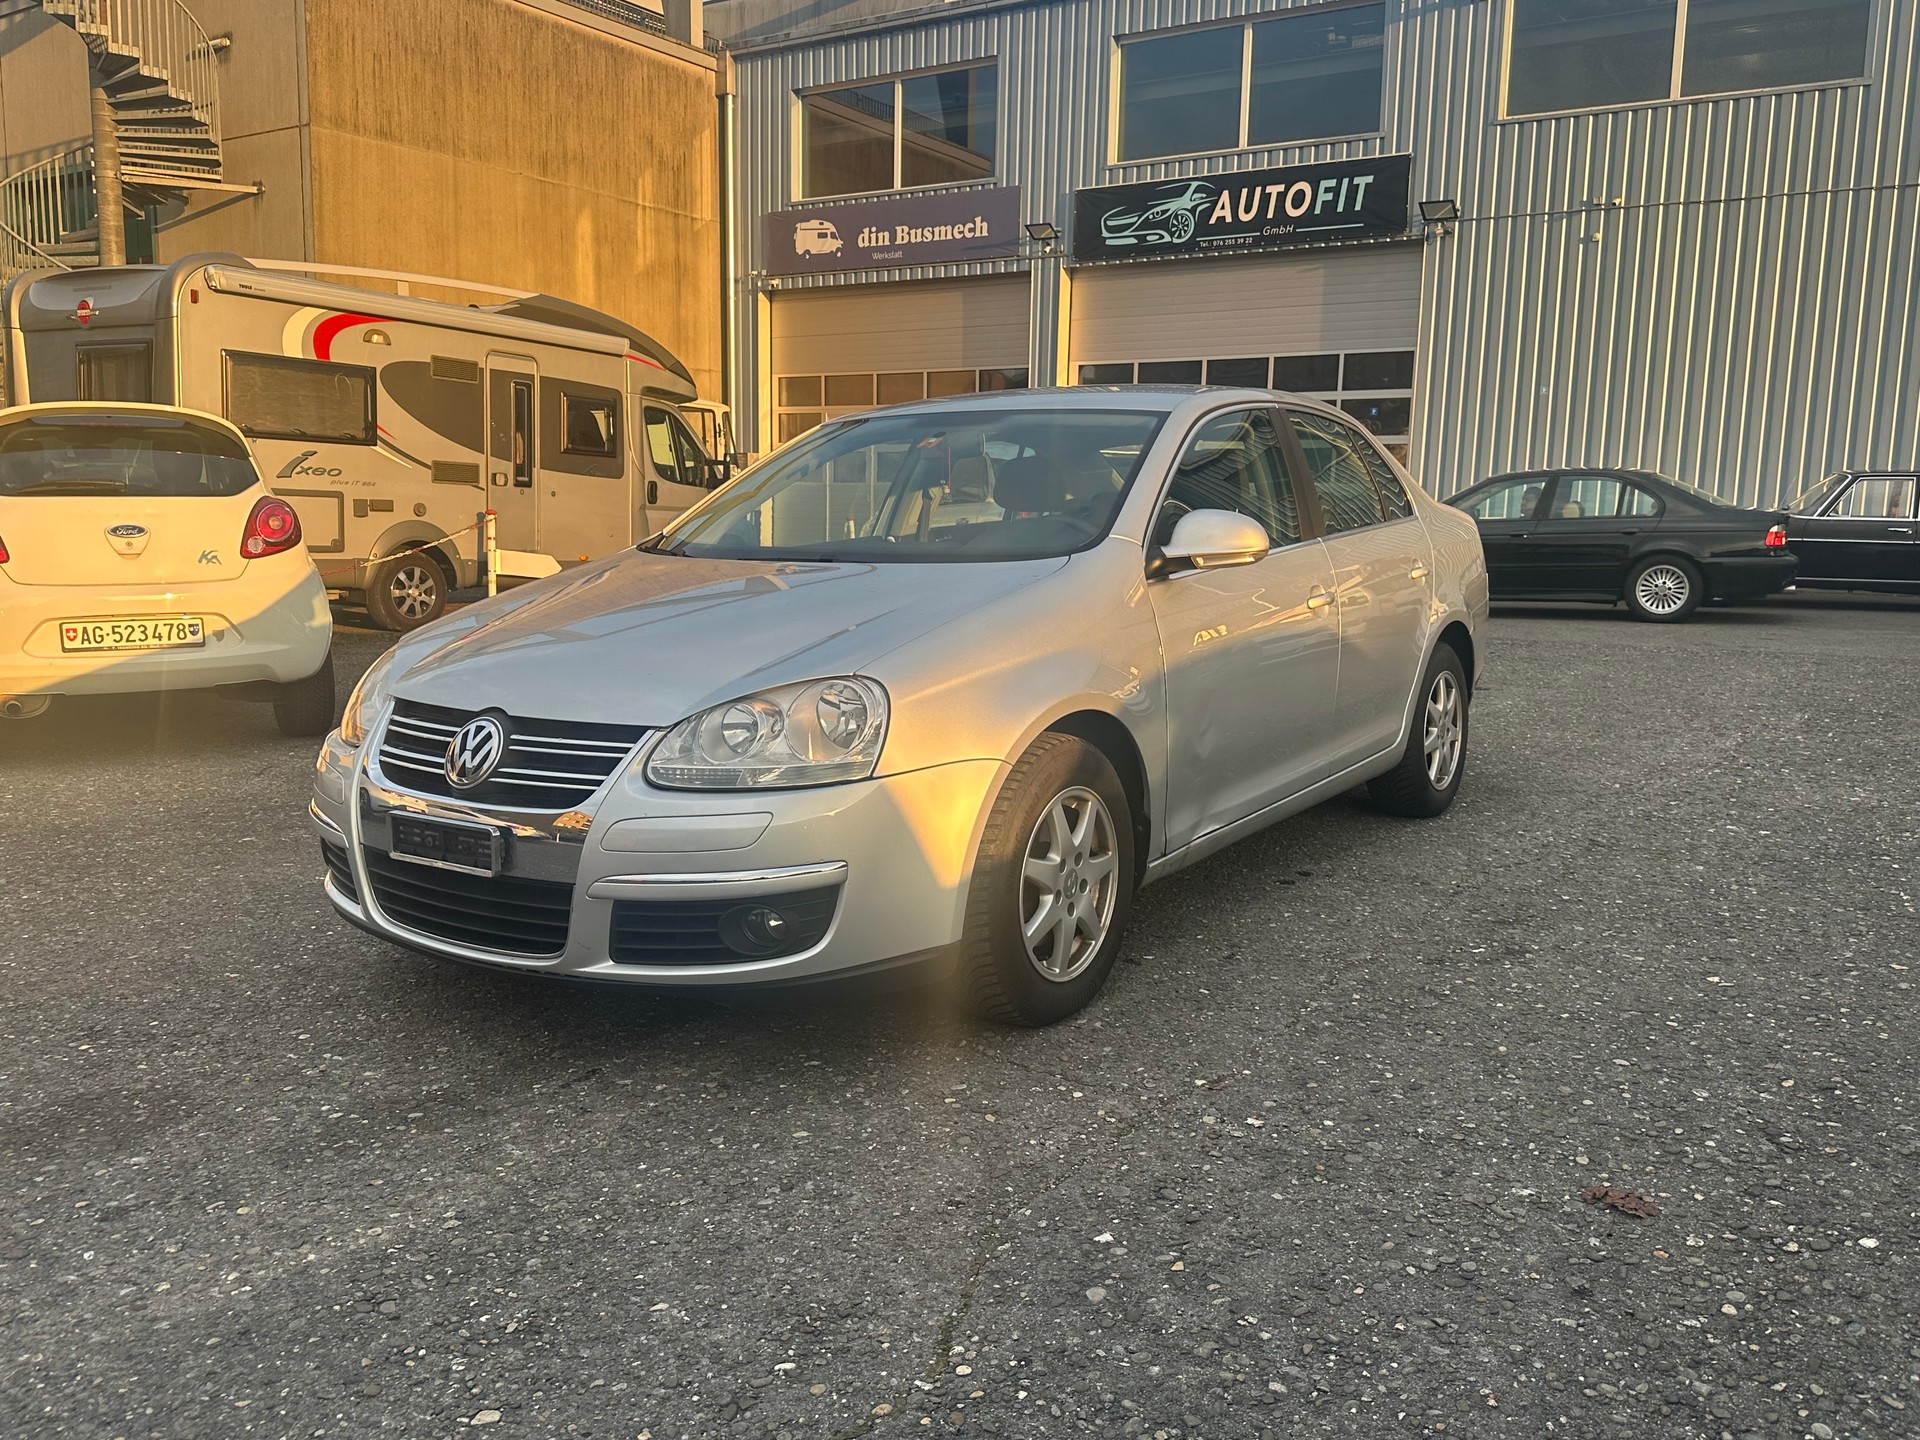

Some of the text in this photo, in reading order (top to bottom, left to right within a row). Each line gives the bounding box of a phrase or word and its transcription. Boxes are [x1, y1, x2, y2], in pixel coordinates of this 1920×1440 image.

[1208, 175, 1374, 225] AUTOFIT
[857, 215, 989, 248] din Busmech
[1263, 224, 1294, 236] GmbH
[871, 250, 903, 261] Werkstatt
[116, 526, 139, 535] Ford
